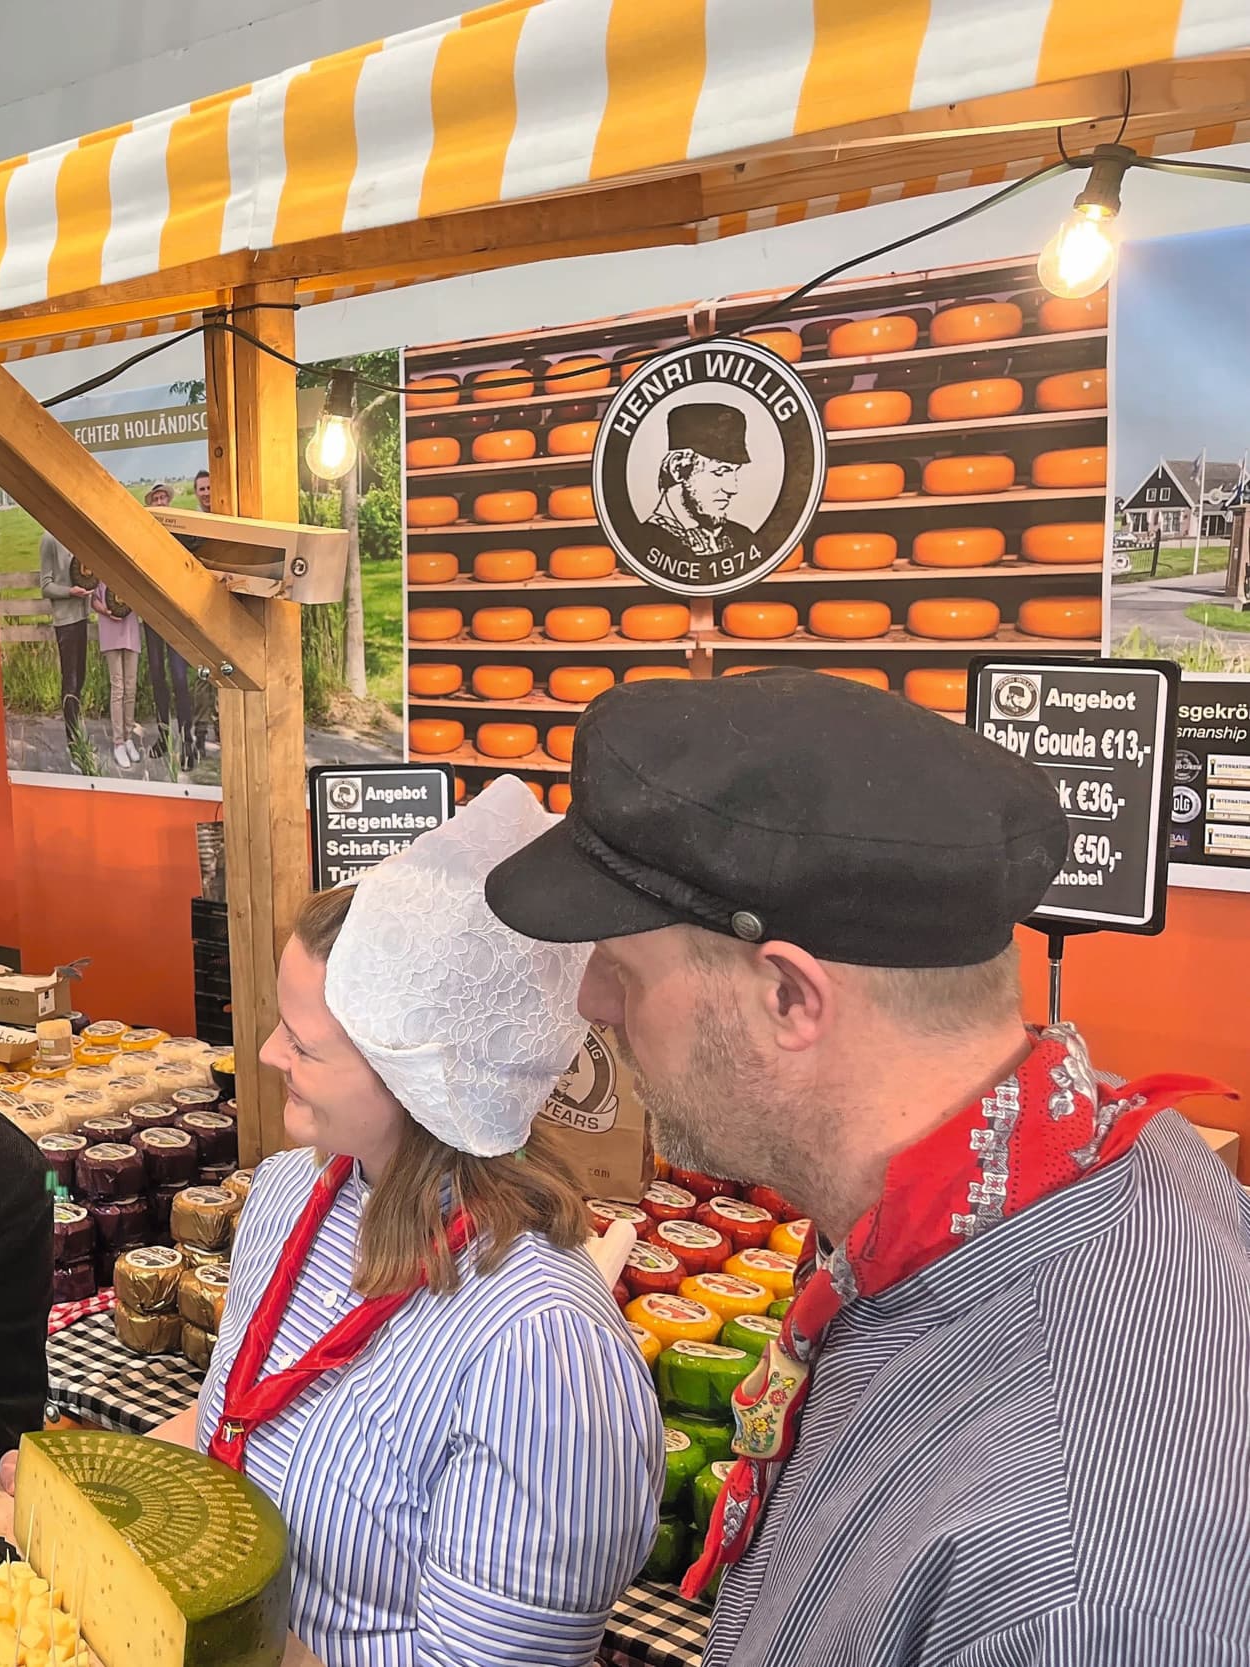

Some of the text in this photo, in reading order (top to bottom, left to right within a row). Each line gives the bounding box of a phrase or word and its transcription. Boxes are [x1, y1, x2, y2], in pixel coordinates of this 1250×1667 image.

[613, 353, 799, 437] HENRI WILLIG
[74, 423, 120, 445] ECHTER
[646, 544, 762, 579] SINCE 1974
[1045, 687, 1137, 712] Angebot
[983, 722, 1030, 758] Baby
[1034, 724, 1096, 758] Gouda
[1100, 728, 1151, 768] €13,-
[1177, 726, 1247, 743] smanship
[365, 785, 428, 804] Angebot
[1076, 780, 1126, 820] €36,-
[327, 813, 438, 832] Ziegenkäse
[1073, 833, 1122, 873] €50,-
[544, 1100, 599, 1130] YEARS
